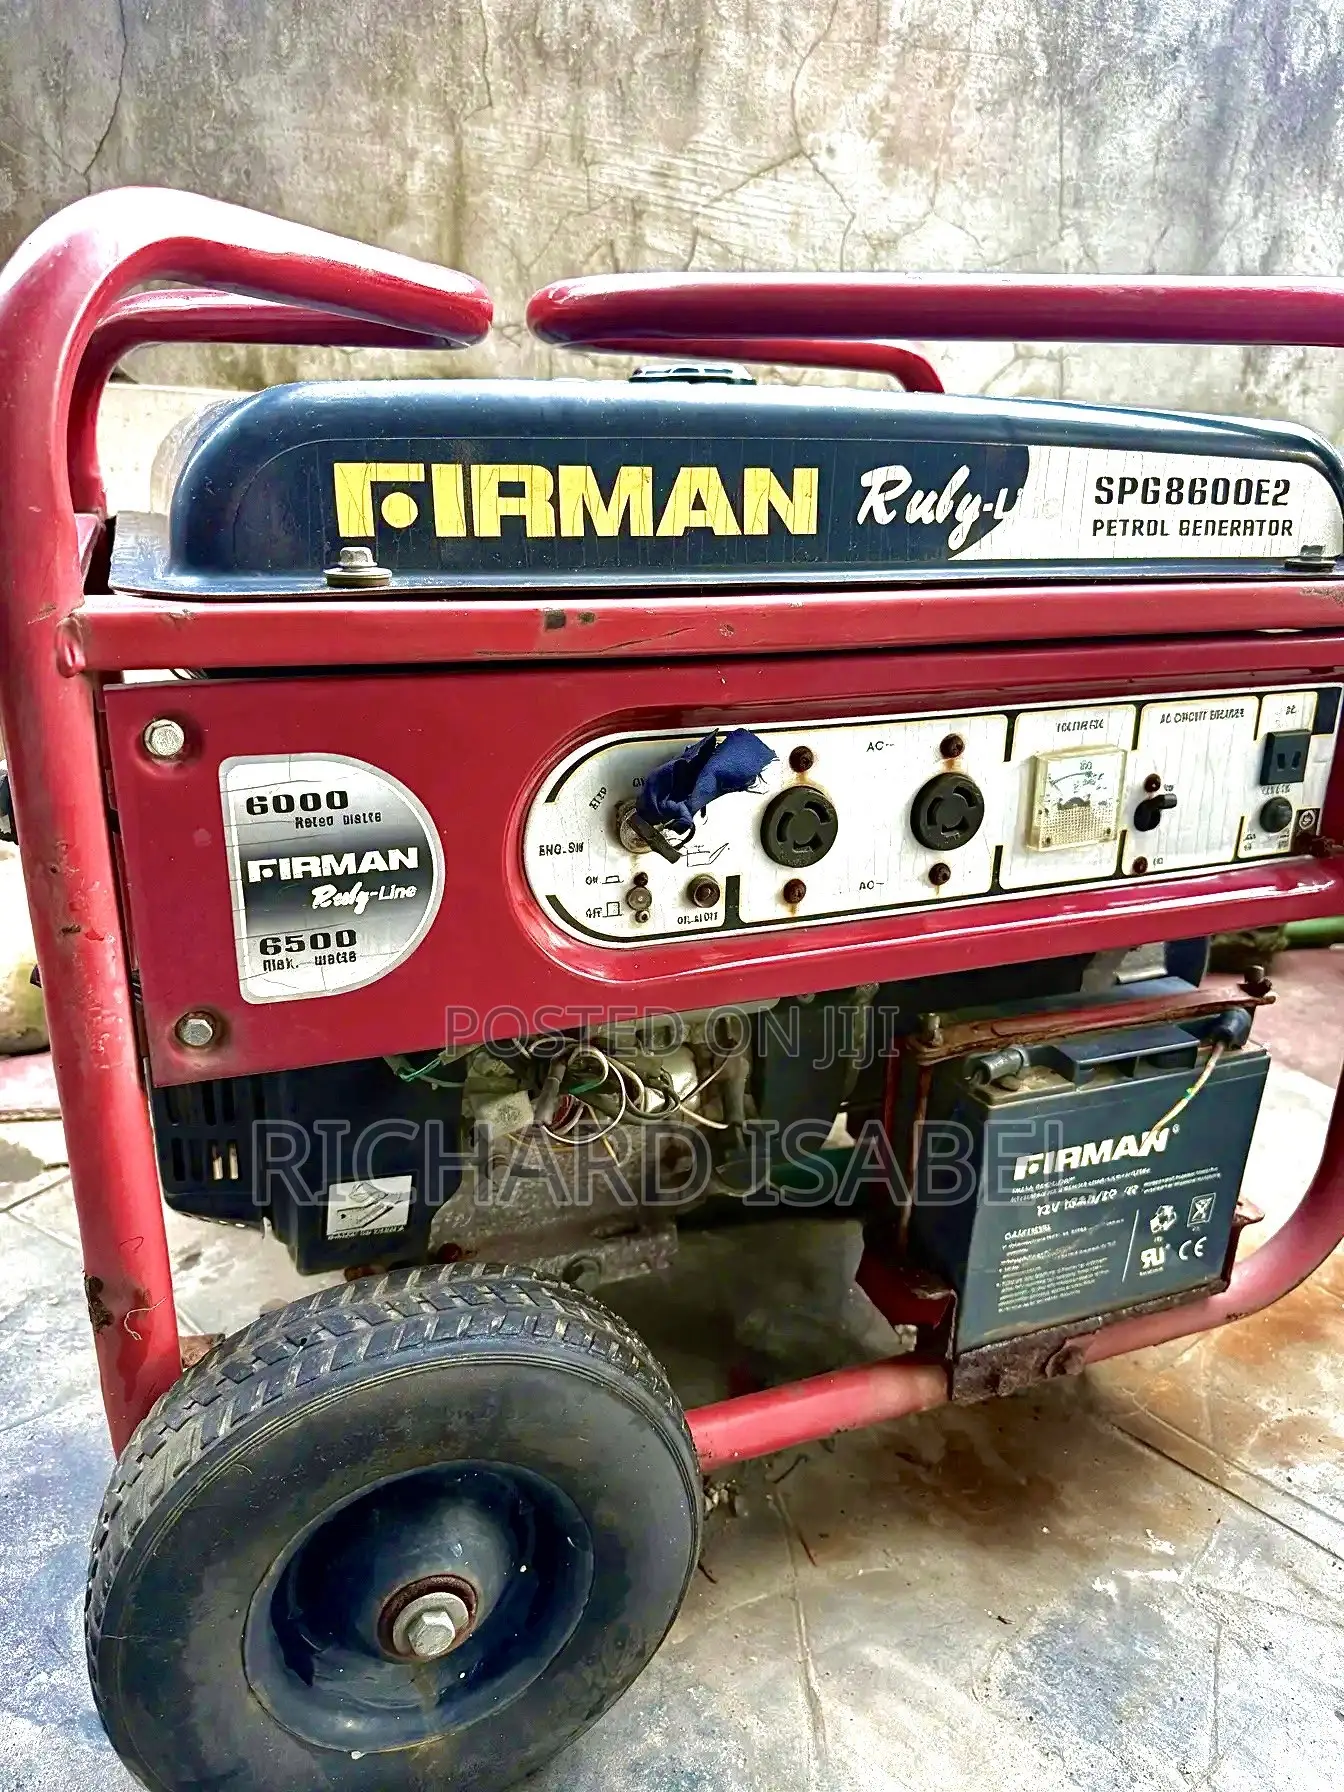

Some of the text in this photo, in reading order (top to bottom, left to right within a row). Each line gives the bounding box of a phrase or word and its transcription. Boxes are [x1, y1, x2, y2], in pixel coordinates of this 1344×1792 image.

[333, 462, 819, 537] FIRMAN
[1094, 476, 1291, 506] SPG8600E2
[1092, 519, 1293, 537] PETROL GENERATOR
[246, 790, 349, 816] 6000
[247, 847, 419, 883] FIRMAN
[311, 881, 418, 915] Ruby-Line
[259, 929, 357, 956] 6500
[1013, 1128, 1169, 1181] FIRMAN
